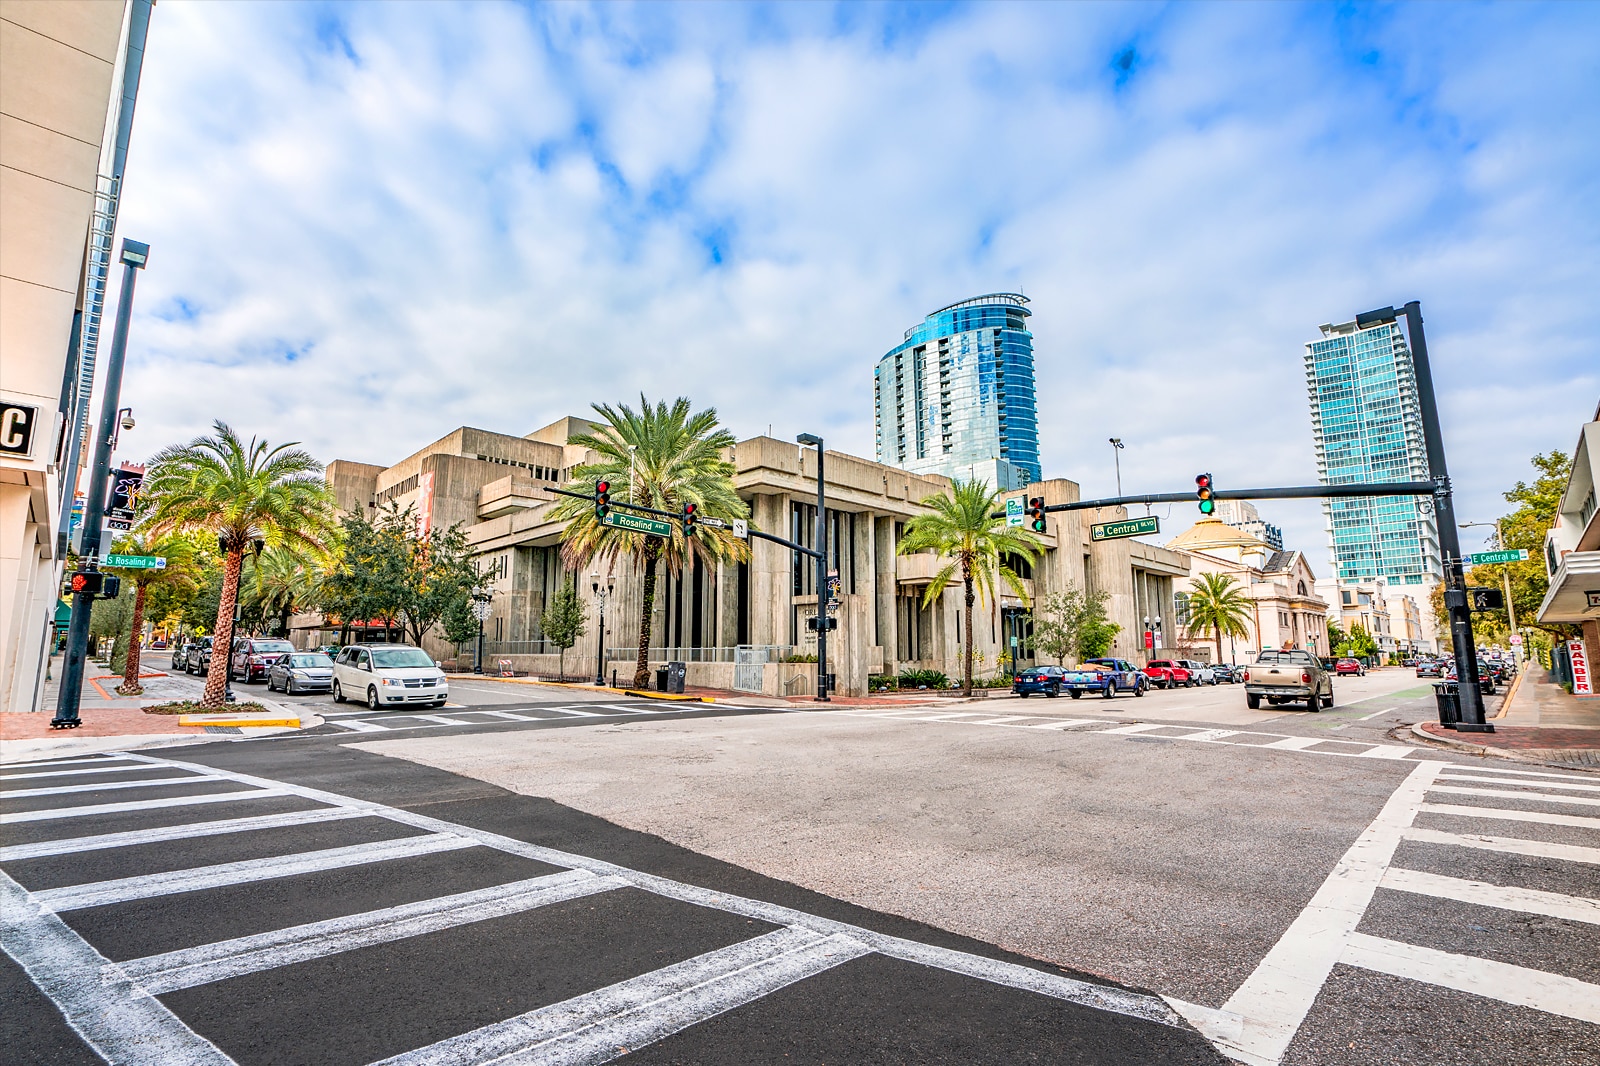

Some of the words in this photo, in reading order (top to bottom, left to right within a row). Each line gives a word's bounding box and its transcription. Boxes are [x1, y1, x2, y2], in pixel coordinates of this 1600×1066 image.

[1, 408, 26, 448] C
[620, 516, 652, 530] Rosalind
[1106, 523, 1139, 535] Central
[107, 556, 113, 565] S
[115, 556, 146, 566] Rosalind
[1472, 555, 1479, 563] E
[1480, 553, 1509, 562] Central
[1569, 643, 1589, 691] BARBER
